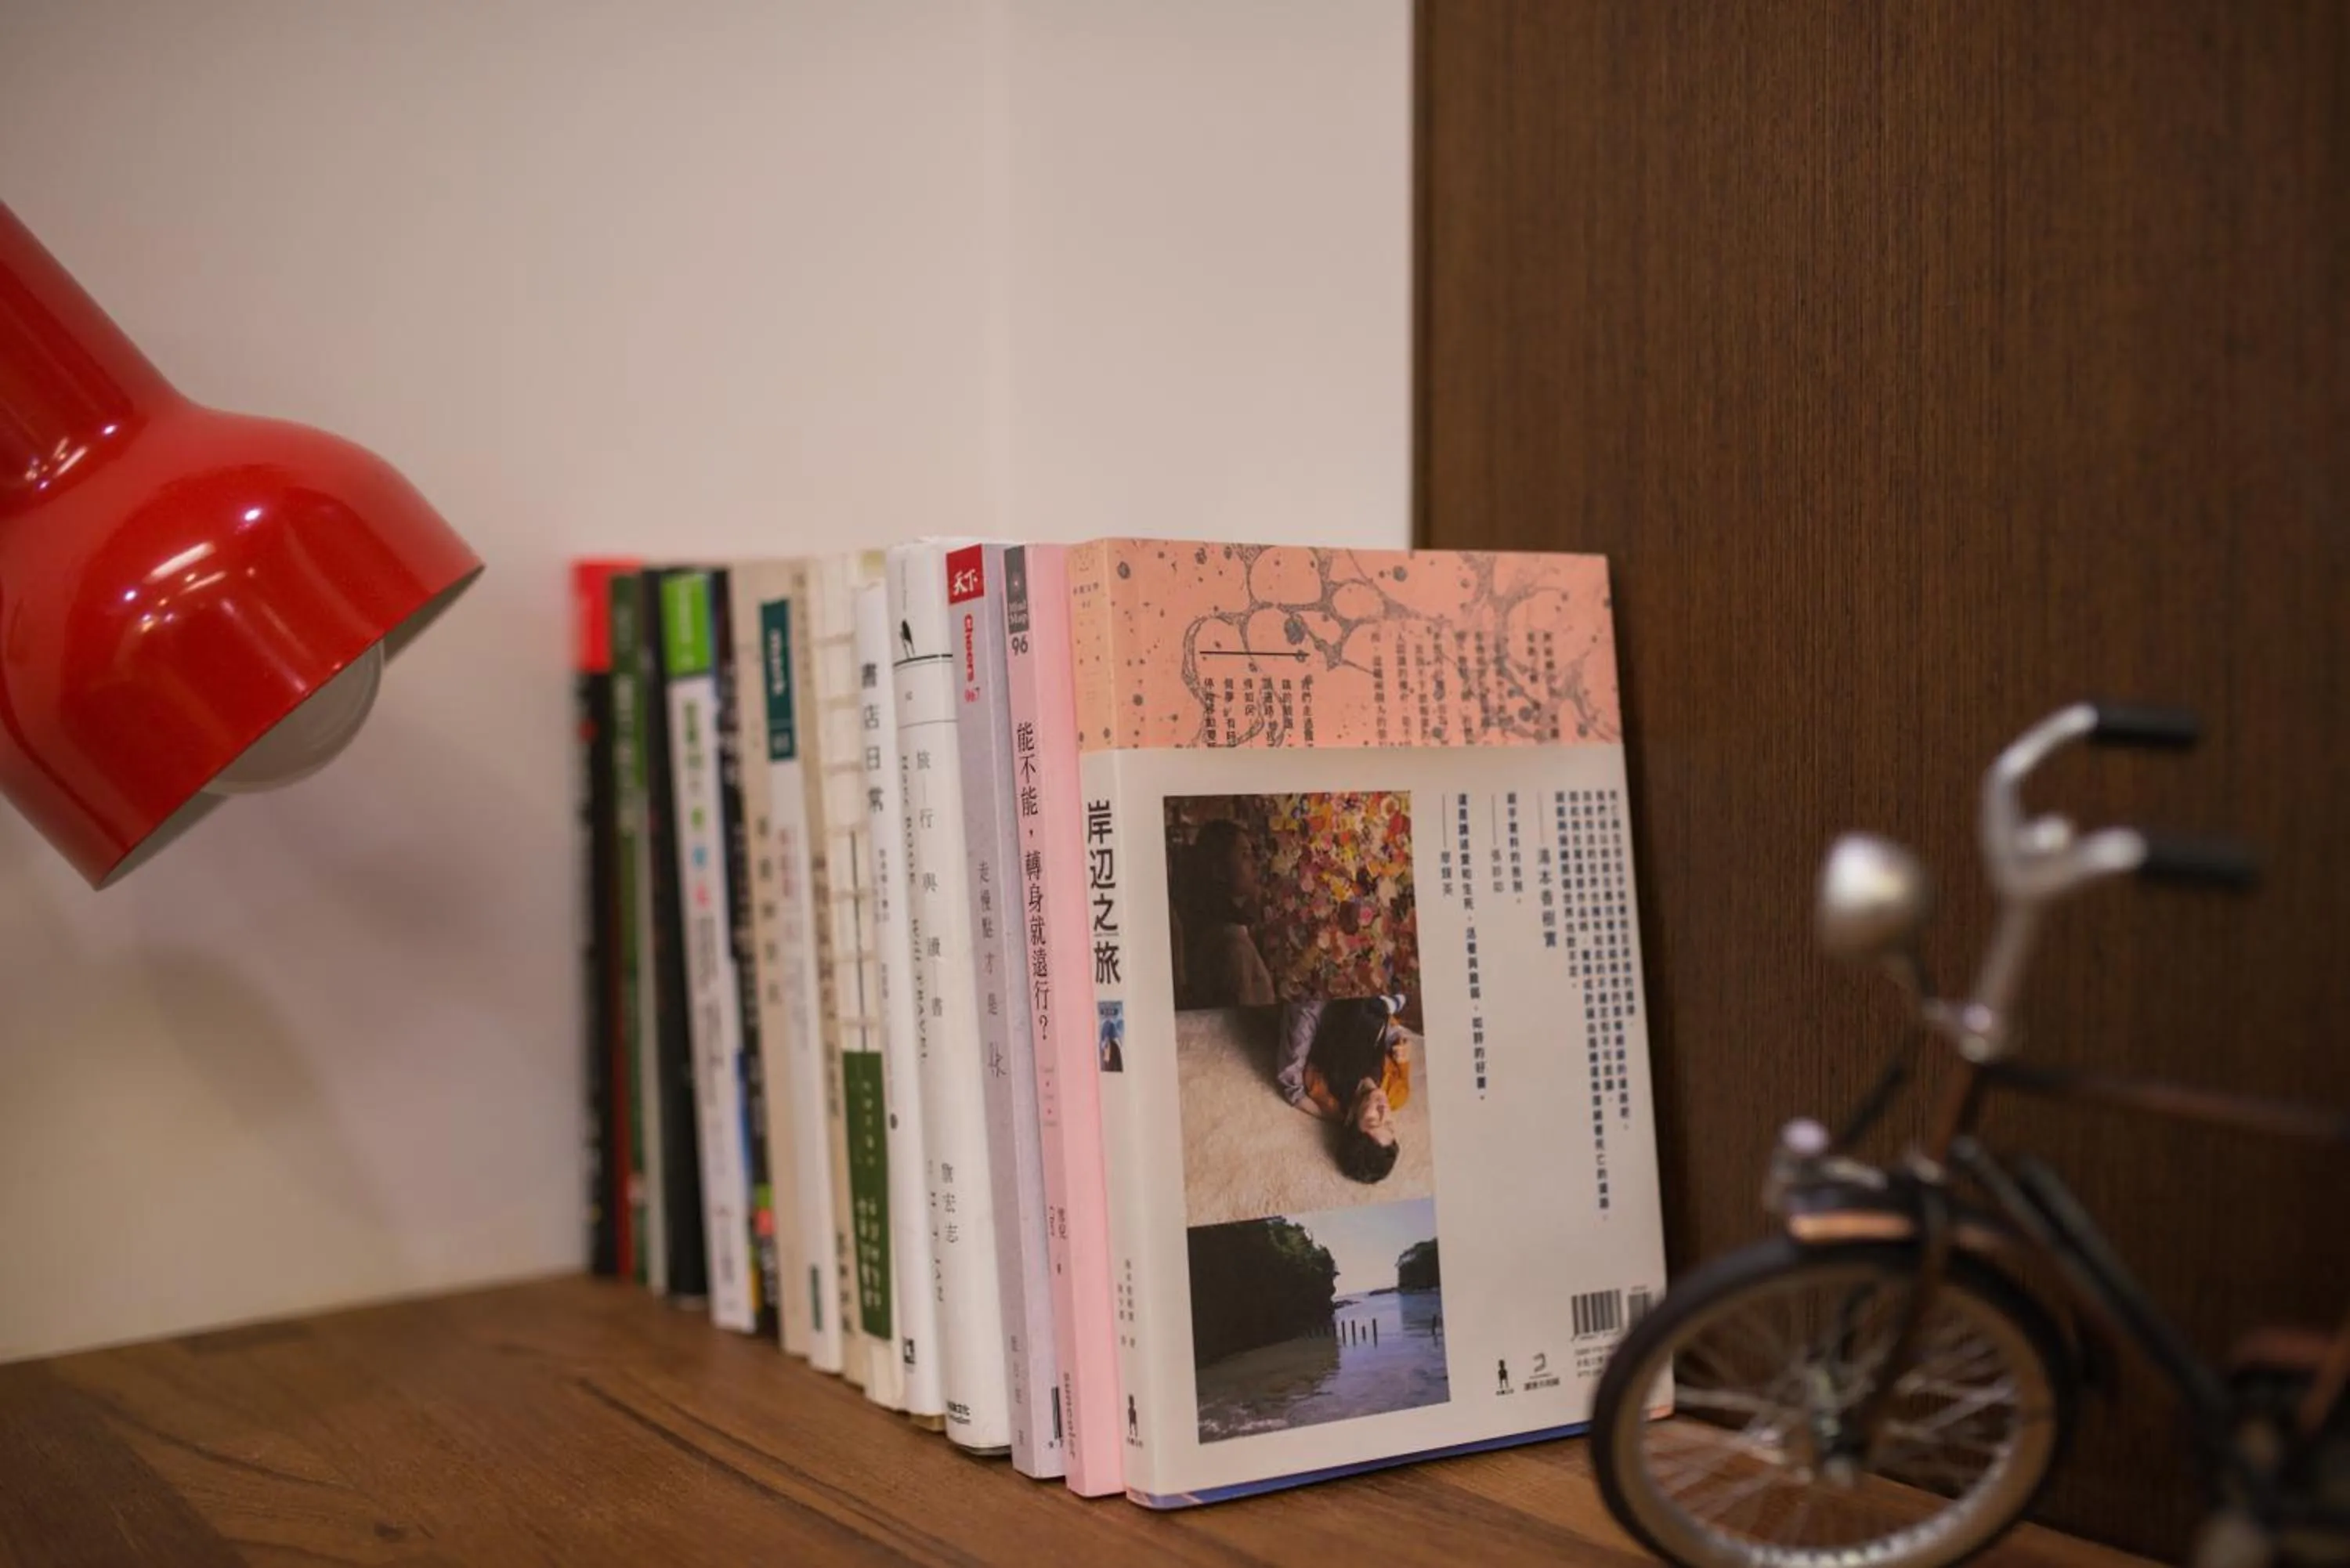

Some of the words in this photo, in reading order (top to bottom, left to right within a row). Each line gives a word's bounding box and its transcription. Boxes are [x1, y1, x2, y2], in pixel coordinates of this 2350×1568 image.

[953, 568, 978, 594] 天下
[1011, 634, 1029, 656] 96
[1087, 800, 1121, 985] 岸辺之旅
